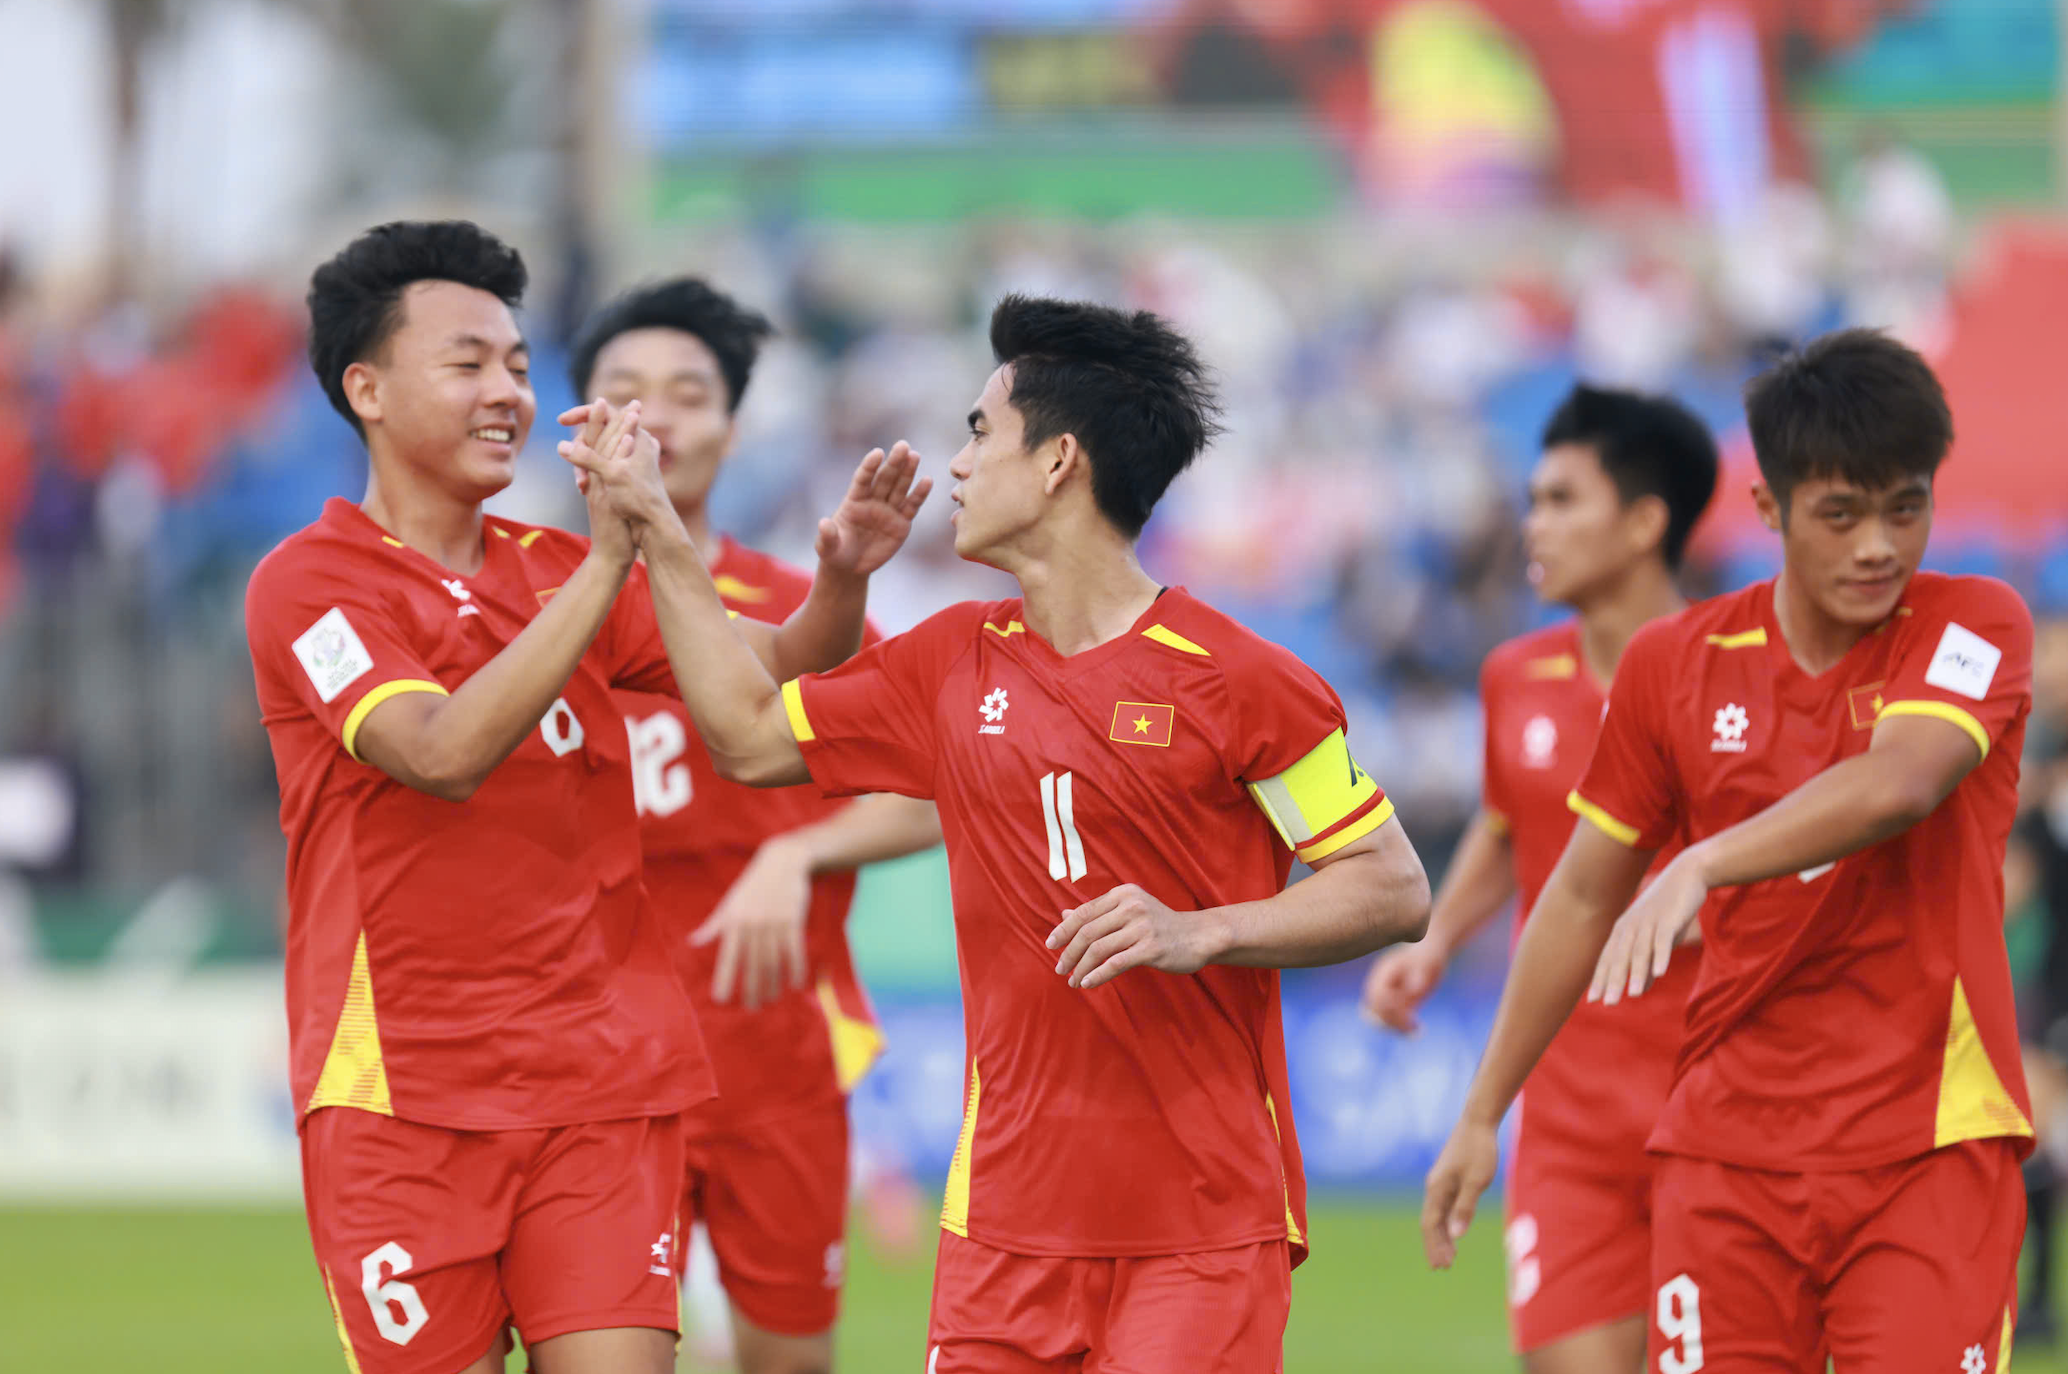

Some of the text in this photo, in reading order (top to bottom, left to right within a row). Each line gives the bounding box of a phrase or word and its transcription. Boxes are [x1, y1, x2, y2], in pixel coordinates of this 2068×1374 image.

[1040, 771, 1087, 883] 11
[361, 1241, 430, 1346] 6
[1657, 1273, 1704, 1374] 9
